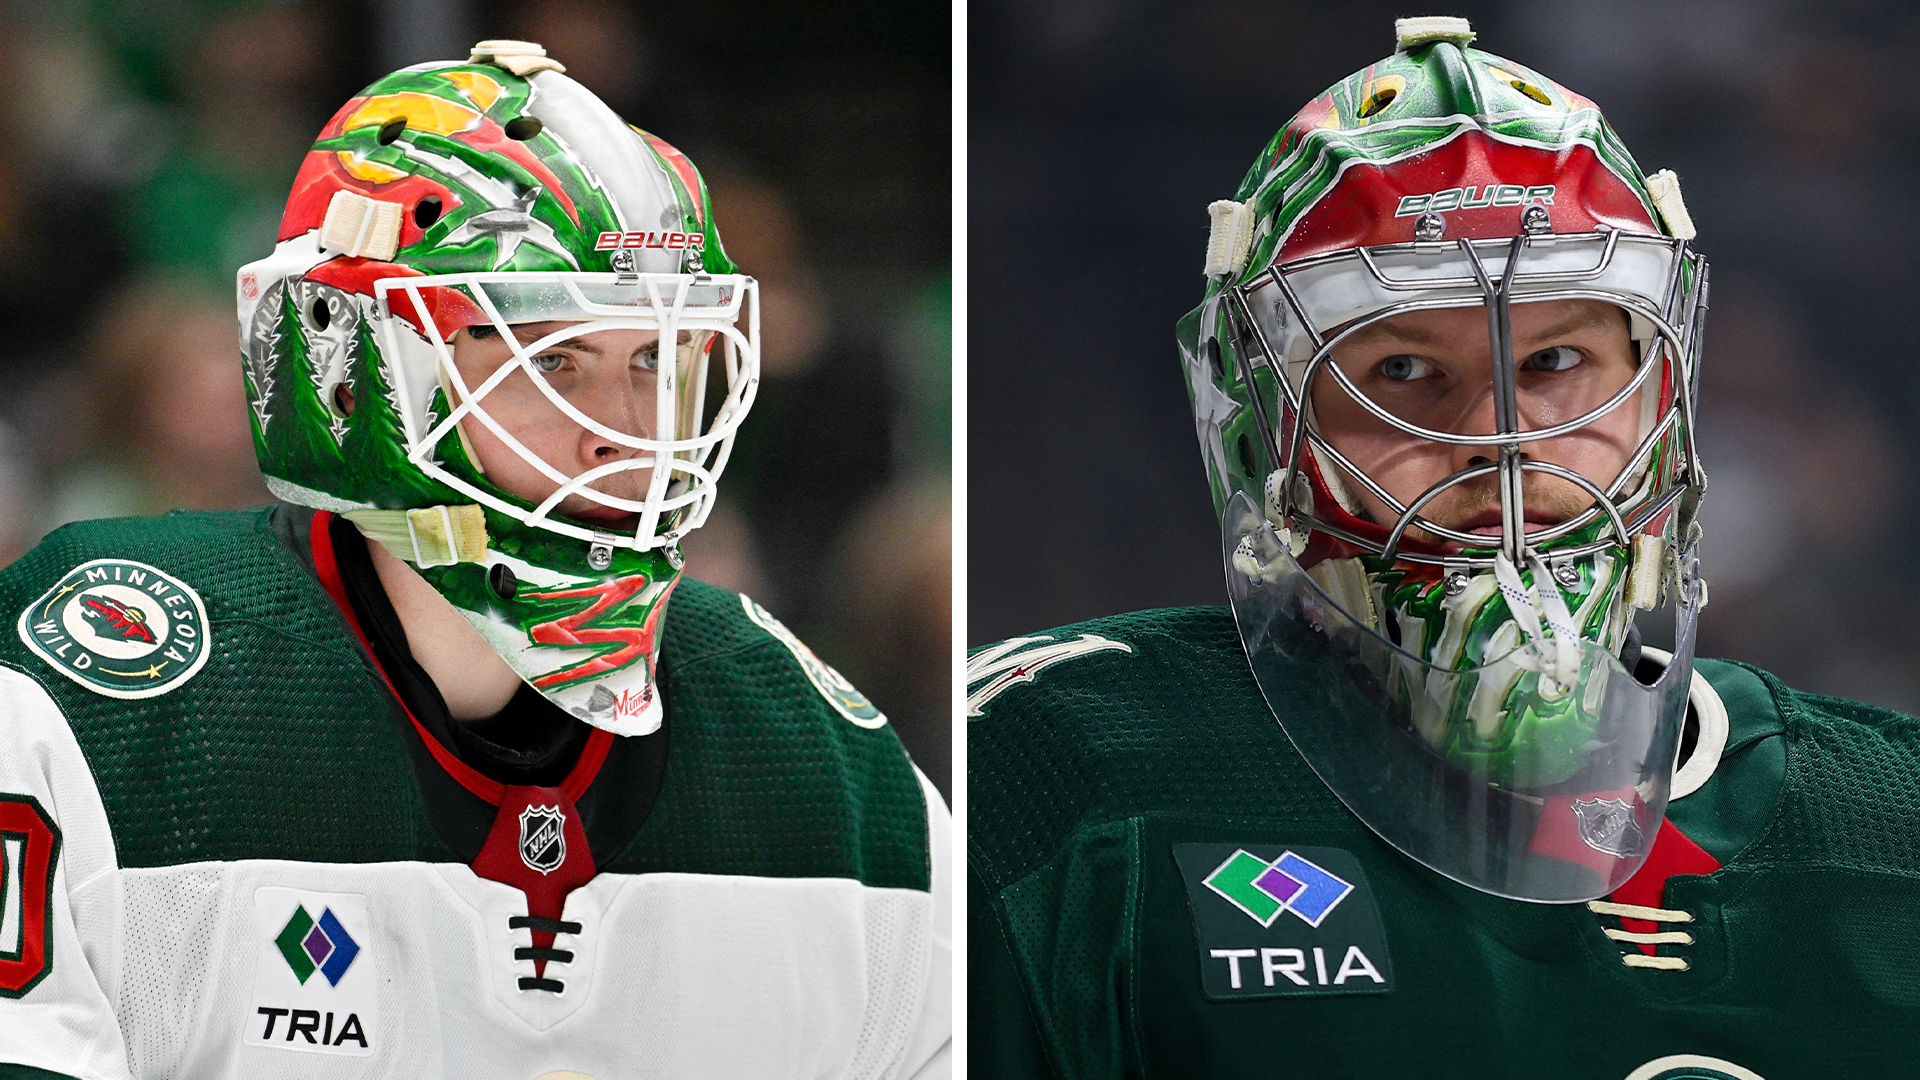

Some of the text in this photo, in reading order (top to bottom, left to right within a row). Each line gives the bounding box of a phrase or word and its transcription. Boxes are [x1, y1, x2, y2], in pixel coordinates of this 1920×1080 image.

[85, 566, 197, 663] MINNESOTA
[34, 618, 92, 670] WILD
[528, 822, 556, 859] NHL
[1209, 945, 1386, 990] TRIA
[257, 1006, 369, 1048] TRIA
